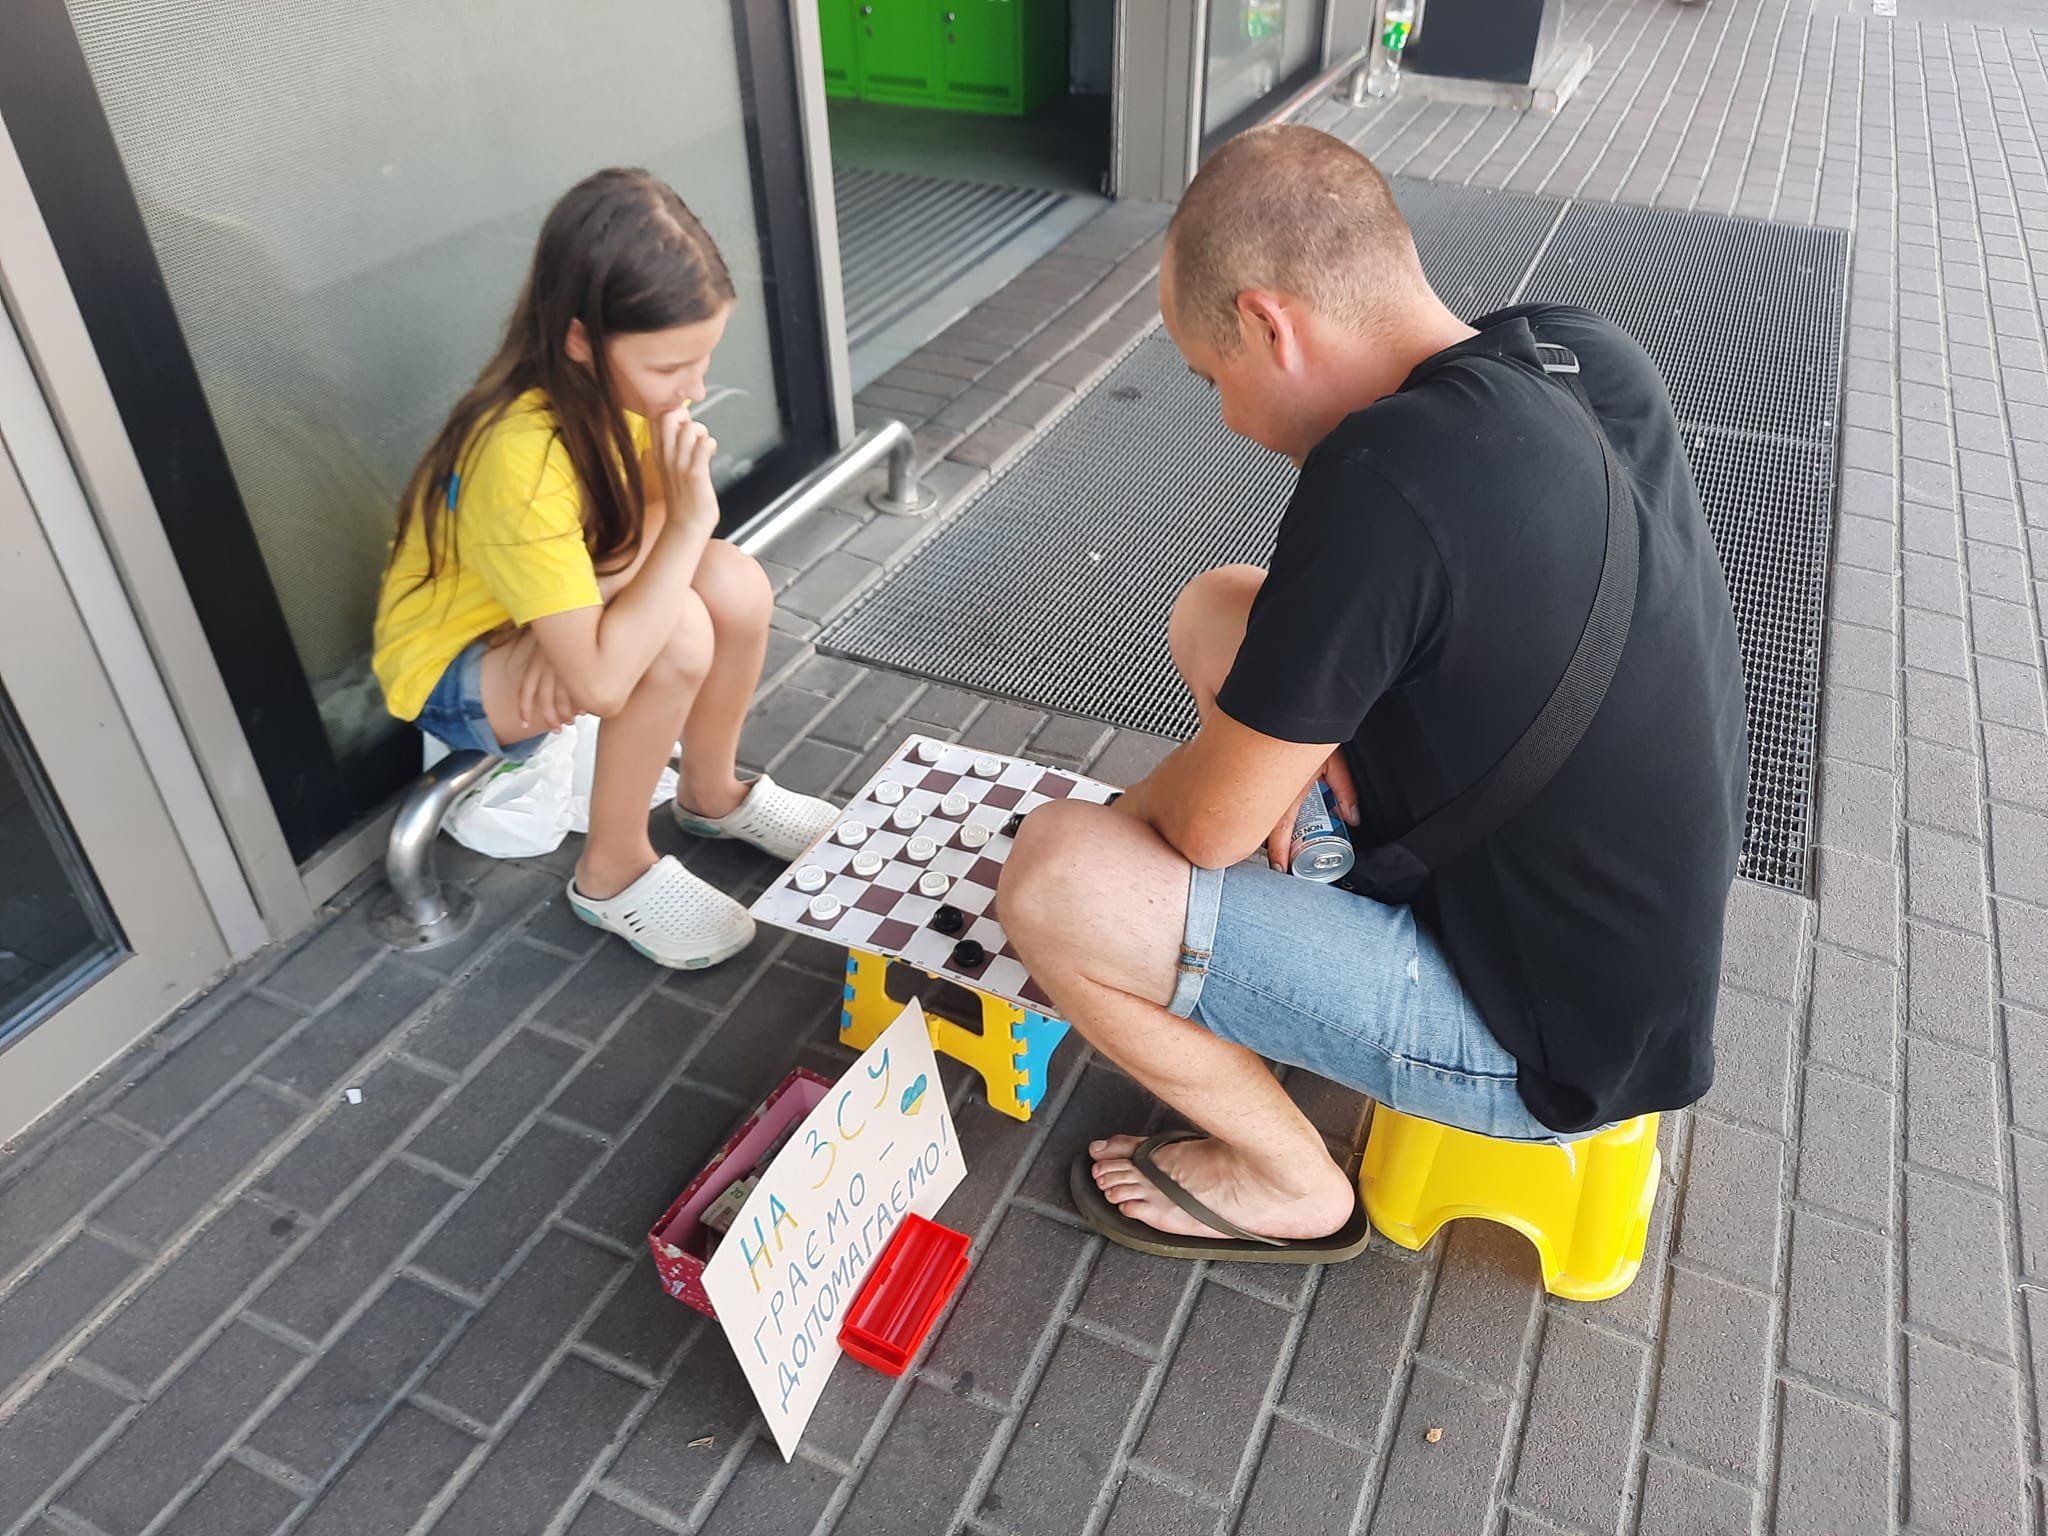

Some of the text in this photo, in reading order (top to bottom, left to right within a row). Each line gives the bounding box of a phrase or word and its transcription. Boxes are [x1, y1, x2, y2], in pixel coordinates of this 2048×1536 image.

[1304, 824, 1323, 833] NON
[738, 1047, 891, 1295] НА ЗСУ
[753, 1171, 866, 1366] ГРАЄМО
[775, 1113, 951, 1415] ДОПОМАГАЄМО!
